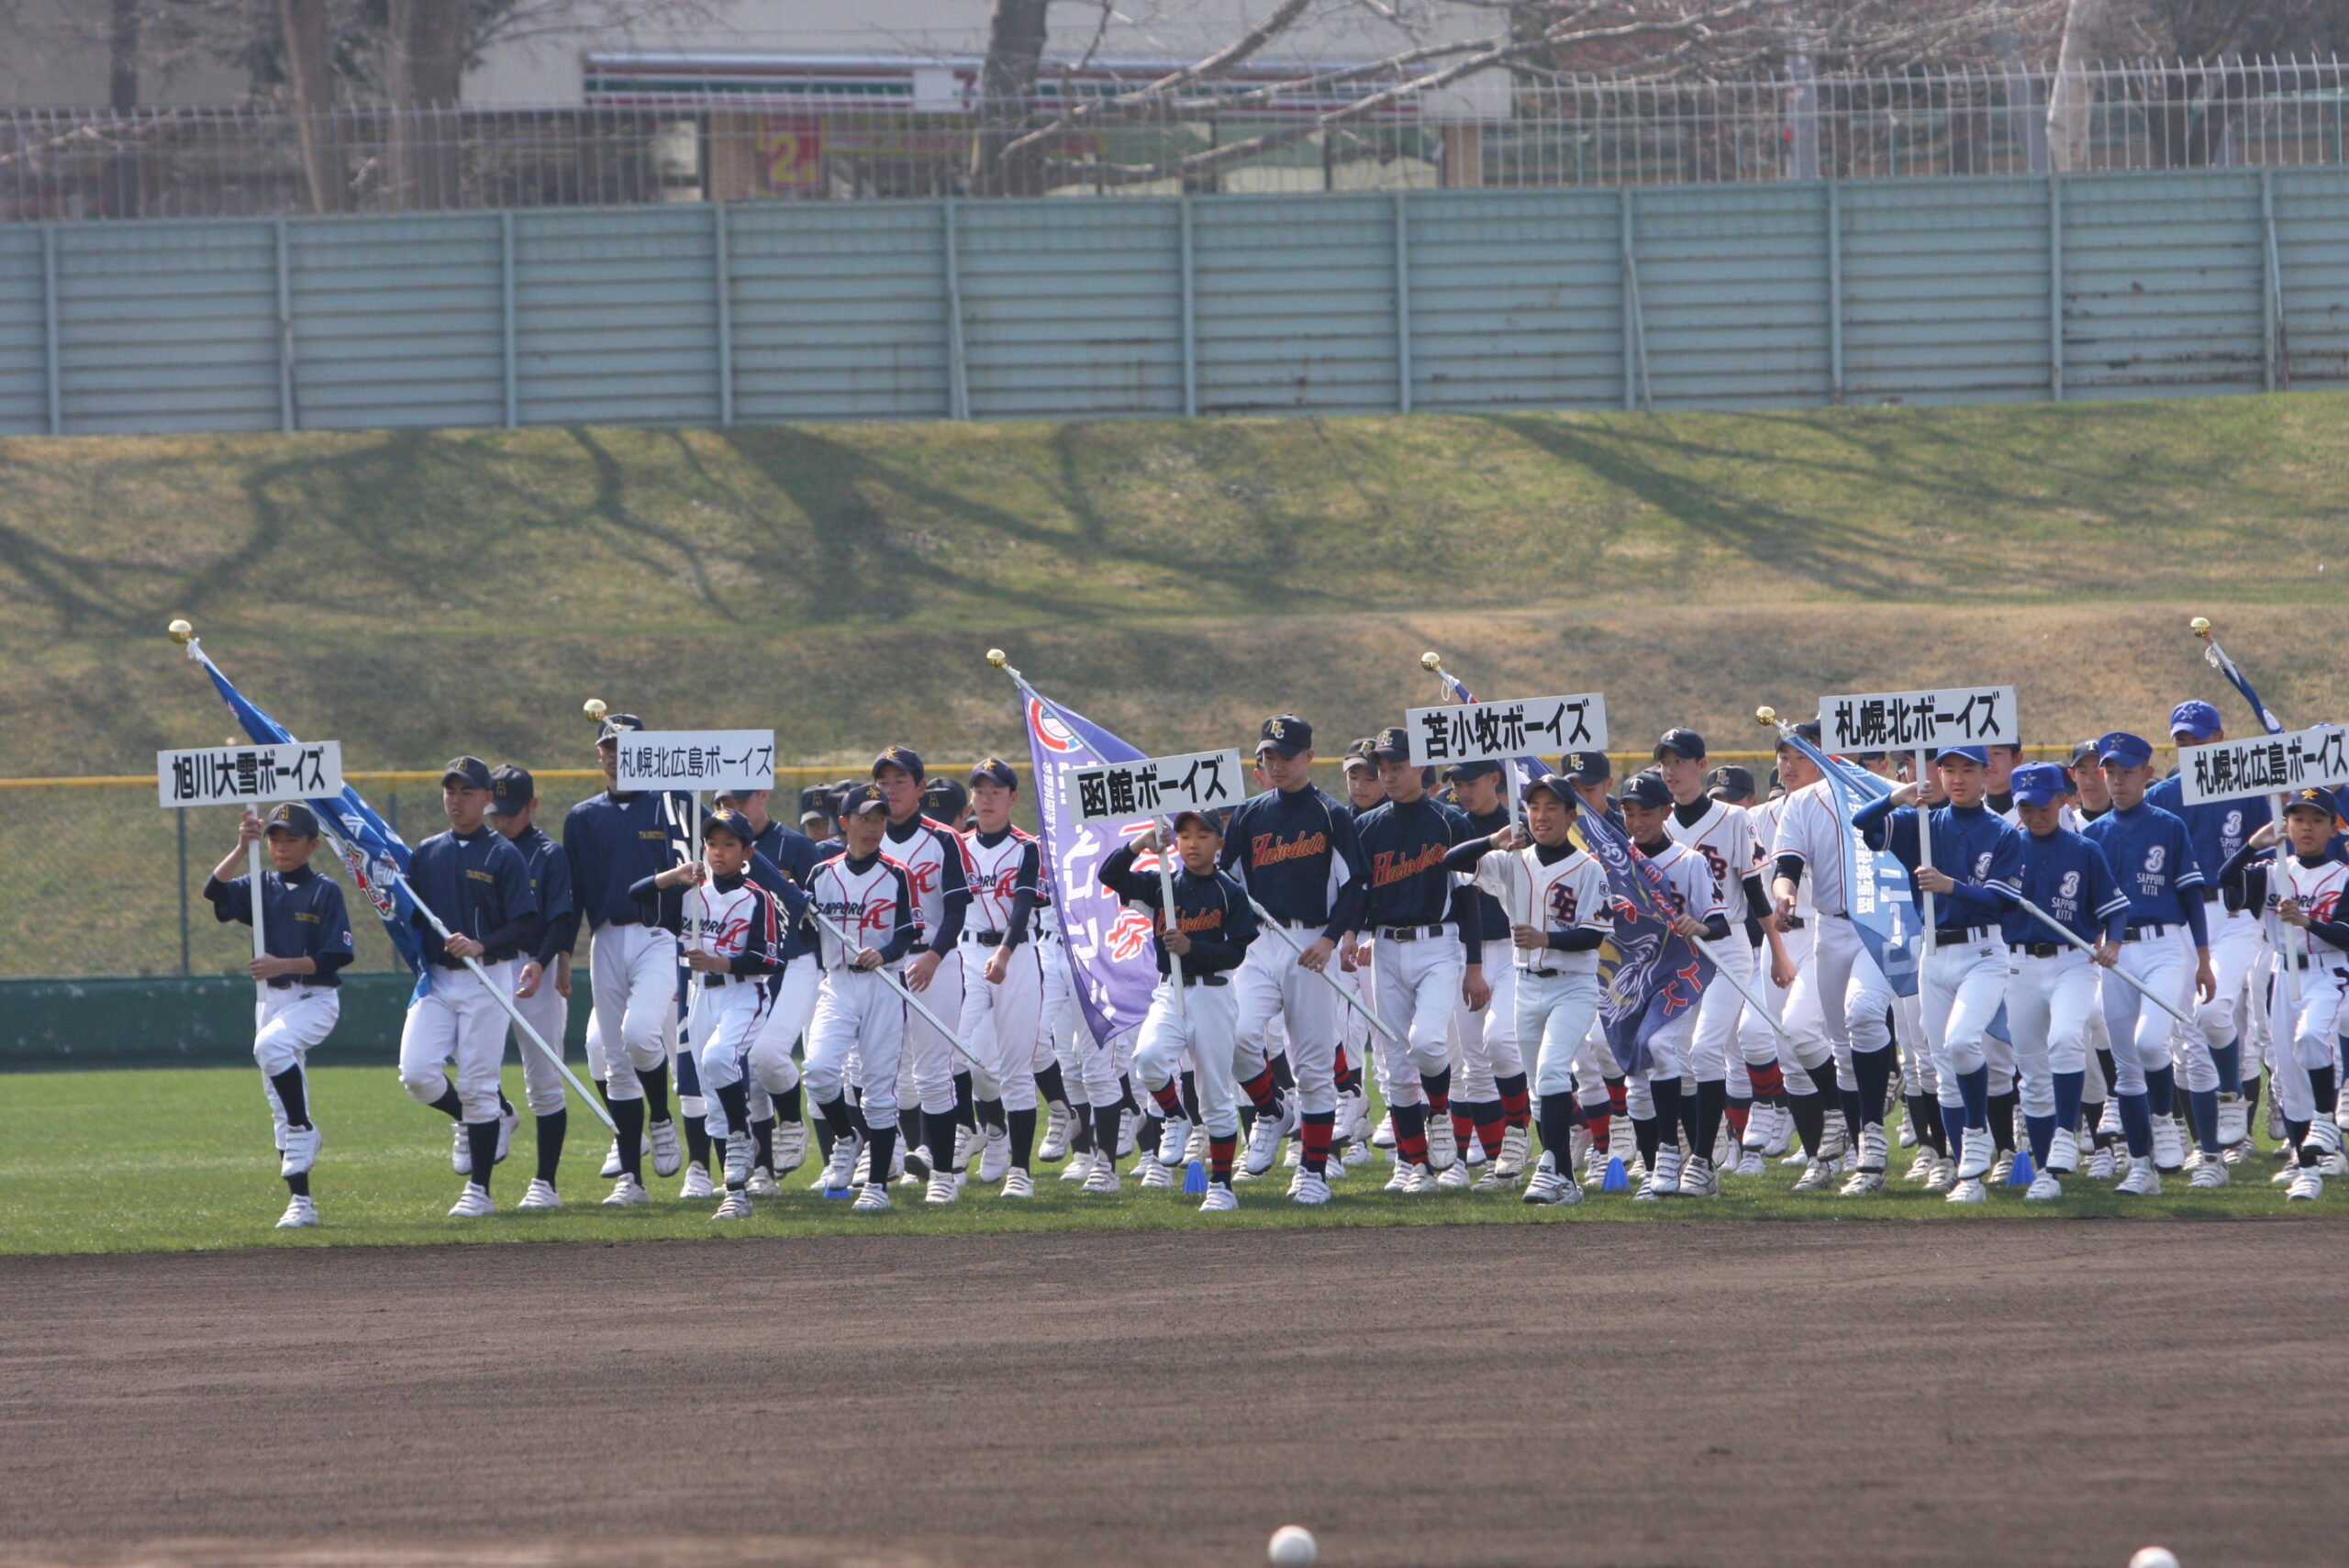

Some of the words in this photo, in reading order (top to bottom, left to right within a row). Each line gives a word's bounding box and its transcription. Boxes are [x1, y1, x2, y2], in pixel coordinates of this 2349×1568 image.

[1422, 698, 1591, 760] 苫小牧ボーイズ
[1835, 691, 2000, 748] 札幌北ボーイズ
[173, 746, 326, 800] 旭川大雪ボーイズ
[619, 745, 773, 778] 札幌北広島ボーイズ
[2195, 728, 2348, 796] 札幌北広島ボーイズ
[1077, 754, 1227, 818] 函館ボーイズ
[1630, 778, 1643, 791] T
[817, 902, 867, 916] SAPPORO
[2142, 885, 2159, 897] KITA
[2055, 908, 2073, 921] KITA
